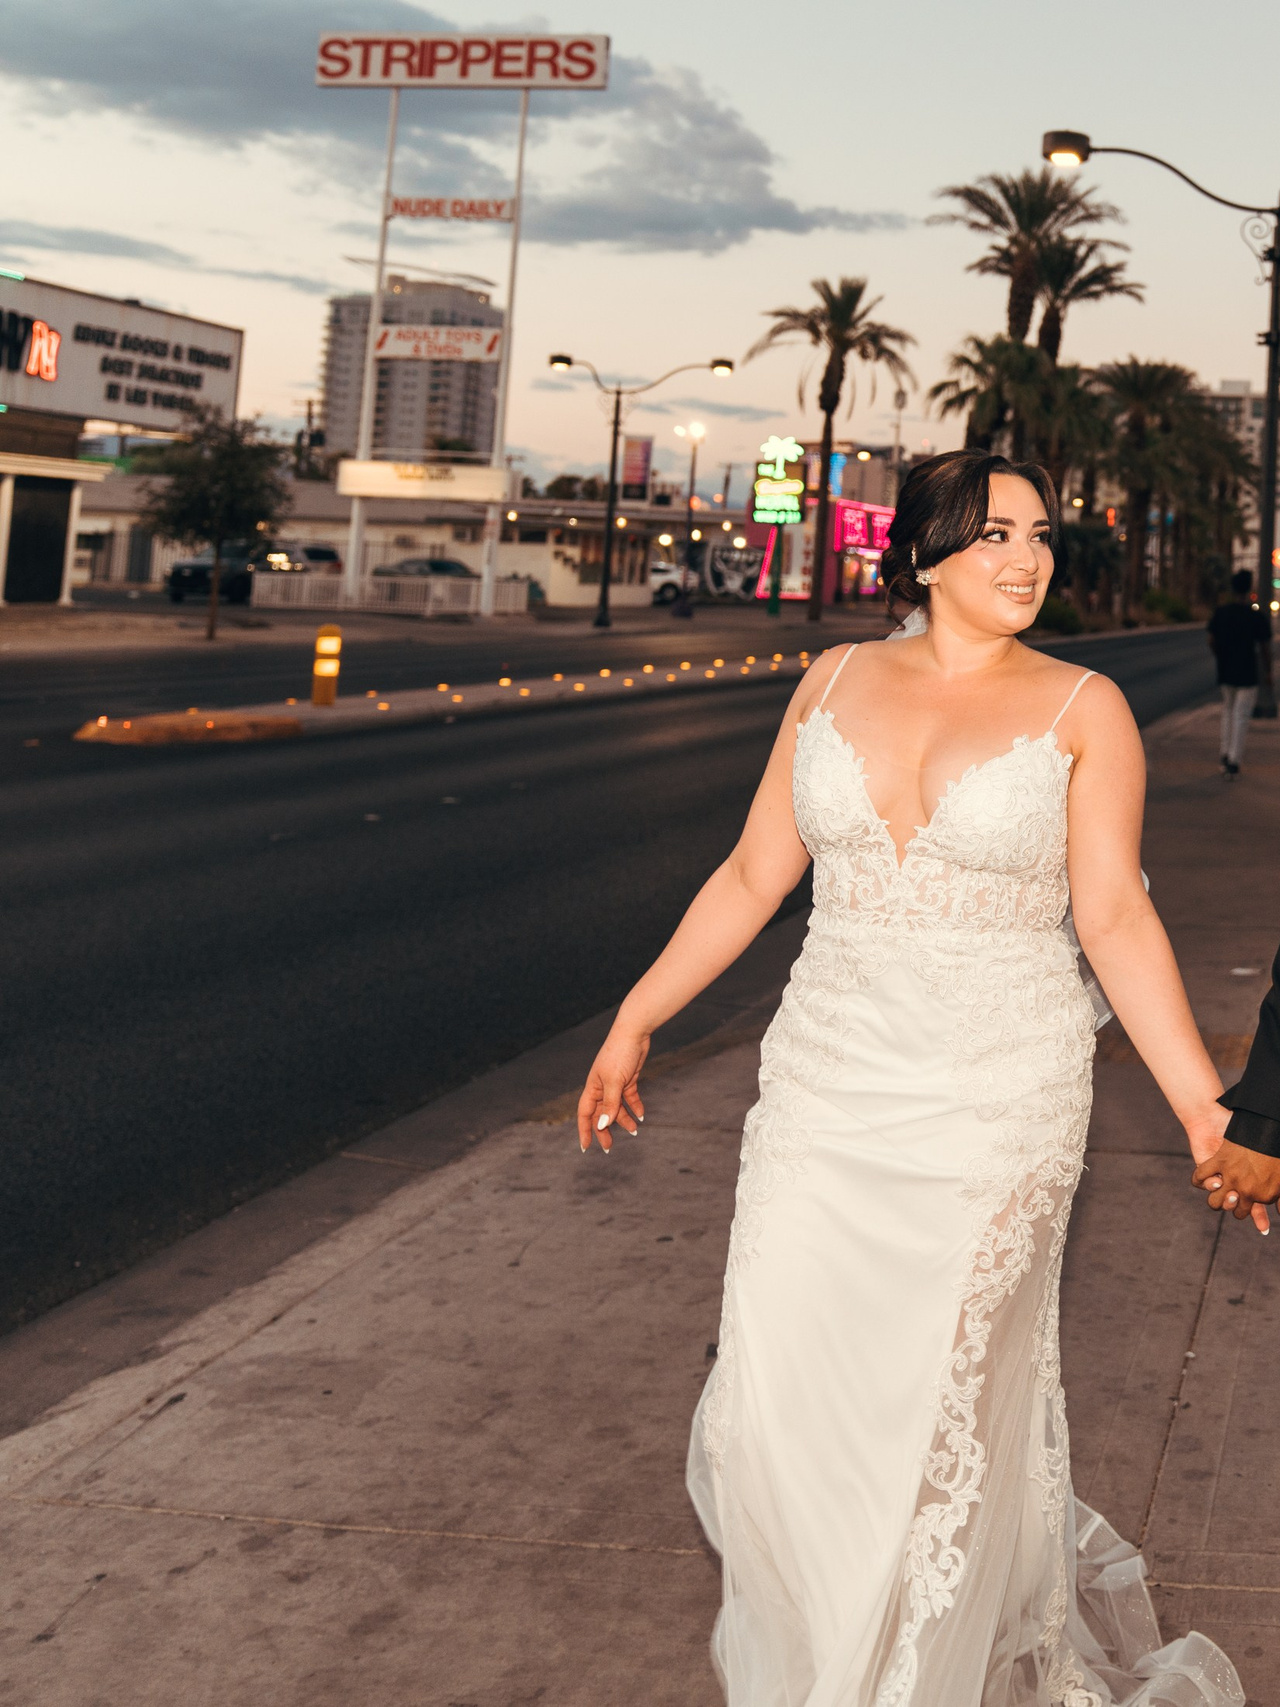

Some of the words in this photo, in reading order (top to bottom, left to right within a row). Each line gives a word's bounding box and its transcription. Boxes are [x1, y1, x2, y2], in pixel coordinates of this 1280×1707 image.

[317, 38, 597, 81] STRIPPERS
[392, 198, 445, 218] NUDE
[451, 199, 506, 221] DAILY
[395, 329, 440, 343] ADULT
[445, 330, 483, 344] TOYS
